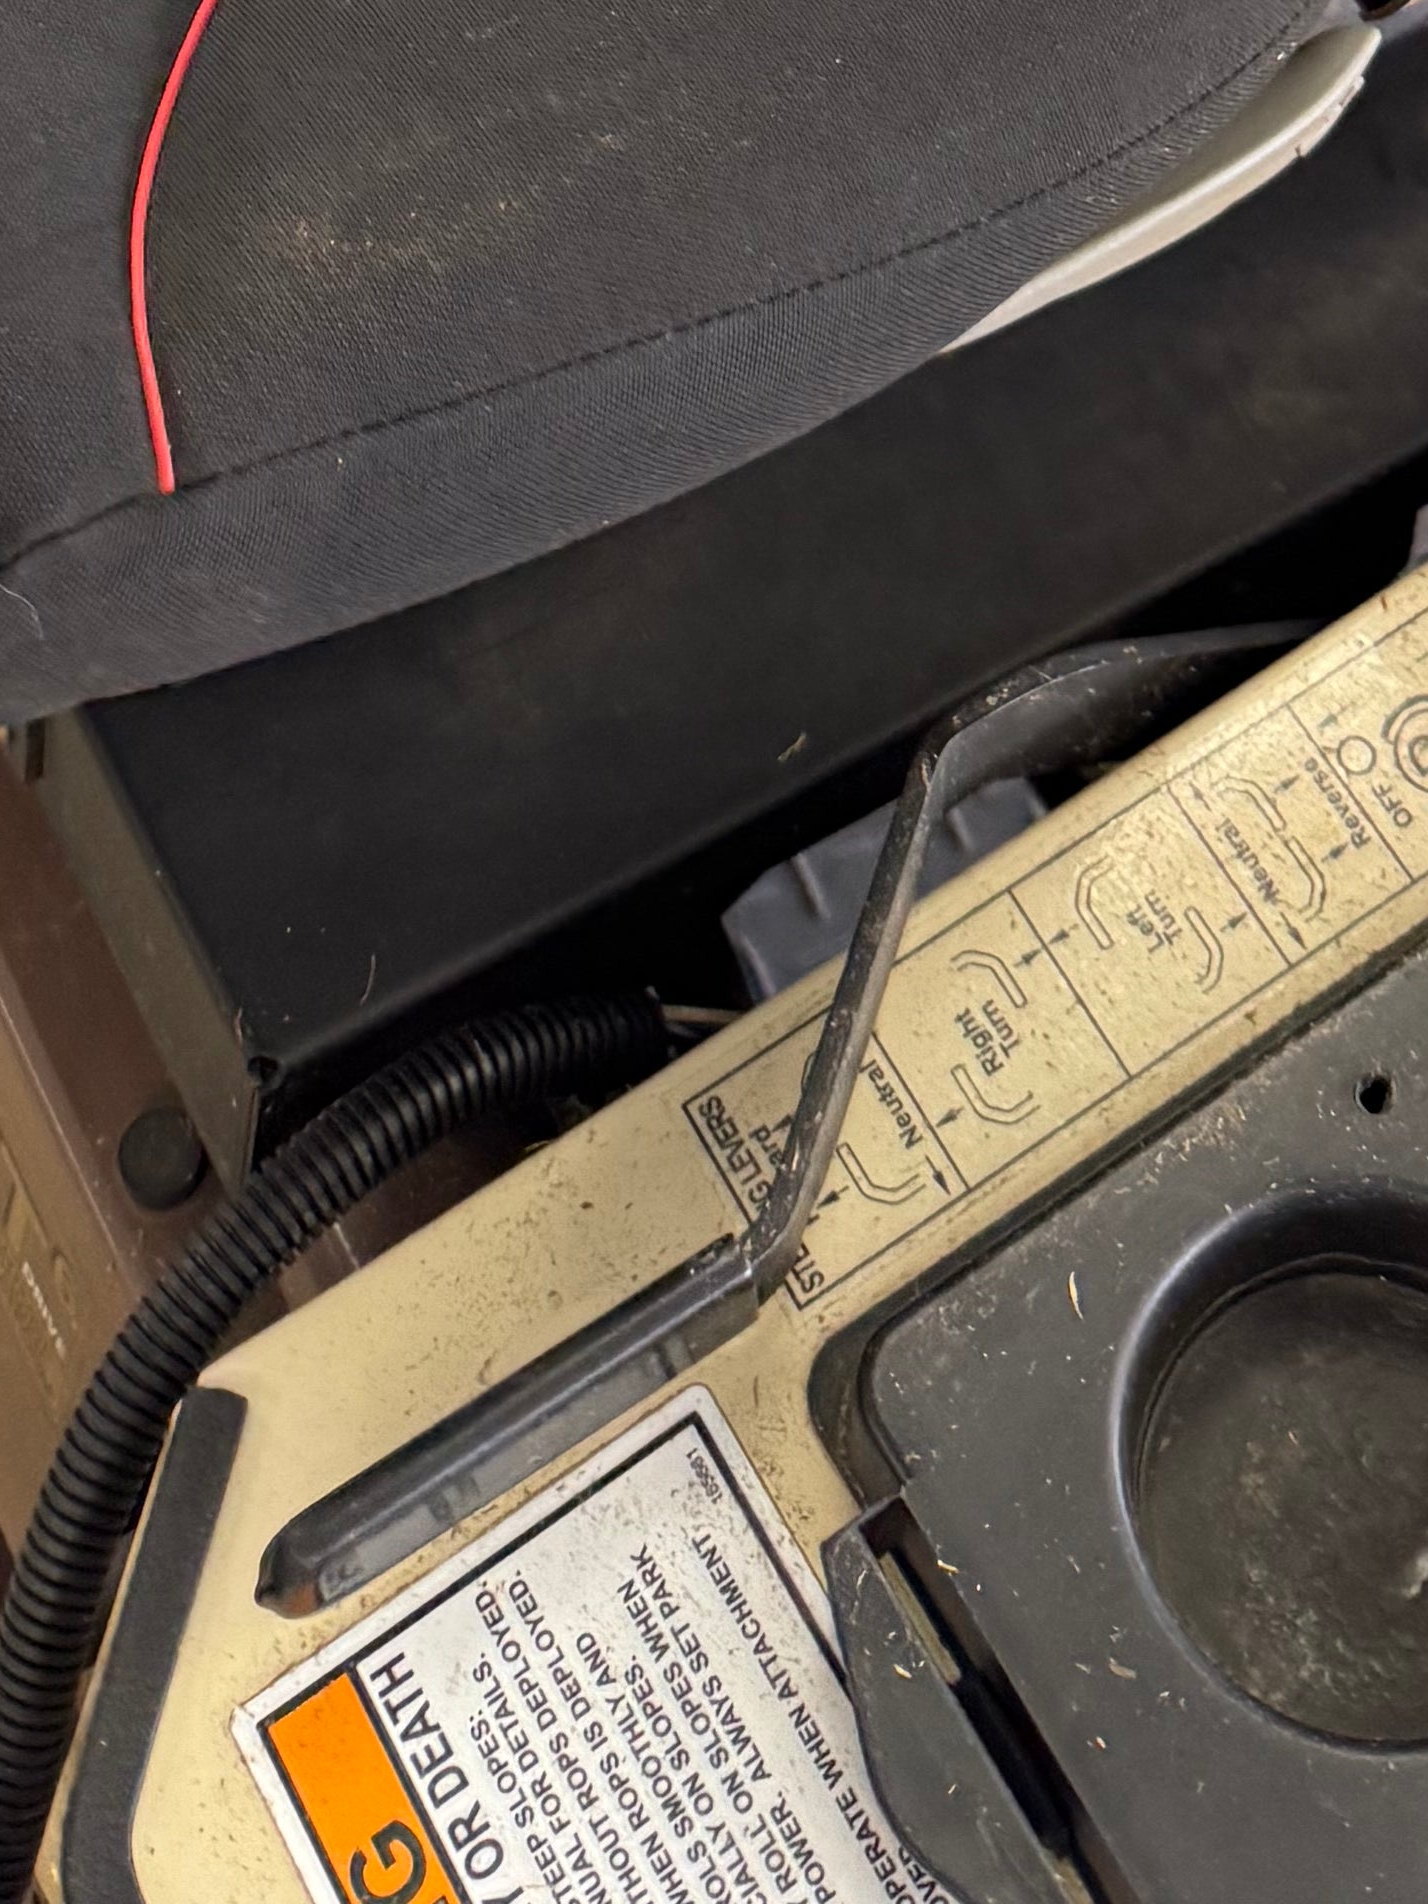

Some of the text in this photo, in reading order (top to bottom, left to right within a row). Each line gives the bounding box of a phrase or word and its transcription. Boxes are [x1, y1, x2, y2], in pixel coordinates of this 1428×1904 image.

[1304, 757, 1372, 850] Reverse
[1371, 784, 1414, 829] OFF
[1215, 818, 1280, 903] Neutral
[1126, 903, 1165, 955] Left
[1144, 889, 1183, 946] Turn
[954, 1007, 1004, 1077] Right
[981, 999, 1021, 1059] Turn
[698, 1095, 762, 1185] LEVERS
[855, 1059, 924, 1150] Neutral
[508, 1569, 592, 1722] DEPLOYED.
[576, 1632, 617, 1687] AND
[691, 1533, 799, 1701] ATTACHMENT
[369, 1651, 470, 1809] DEATH
[475, 1580, 648, 1904] THOUT ROPS DEPLOYED.
[583, 1721, 609, 1752] IS
[604, 1694, 694, 1839] SMOOTHLY
[616, 1578, 798, 1895] ROLL ON SLOPES WHEN
[630, 1543, 837, 1904] POWER. ALWAYS SET PARK
[788, 1702, 844, 1791] WHEN
[469, 1709, 535, 1829] SLOPES:
[472, 1652, 613, 1904] NUAL FOR DETAILS.
[599, 1751, 651, 1832] ROPS
[624, 1655, 768, 1904] CIALLY ON SLOPES.
[447, 1800, 504, 1880] OR
